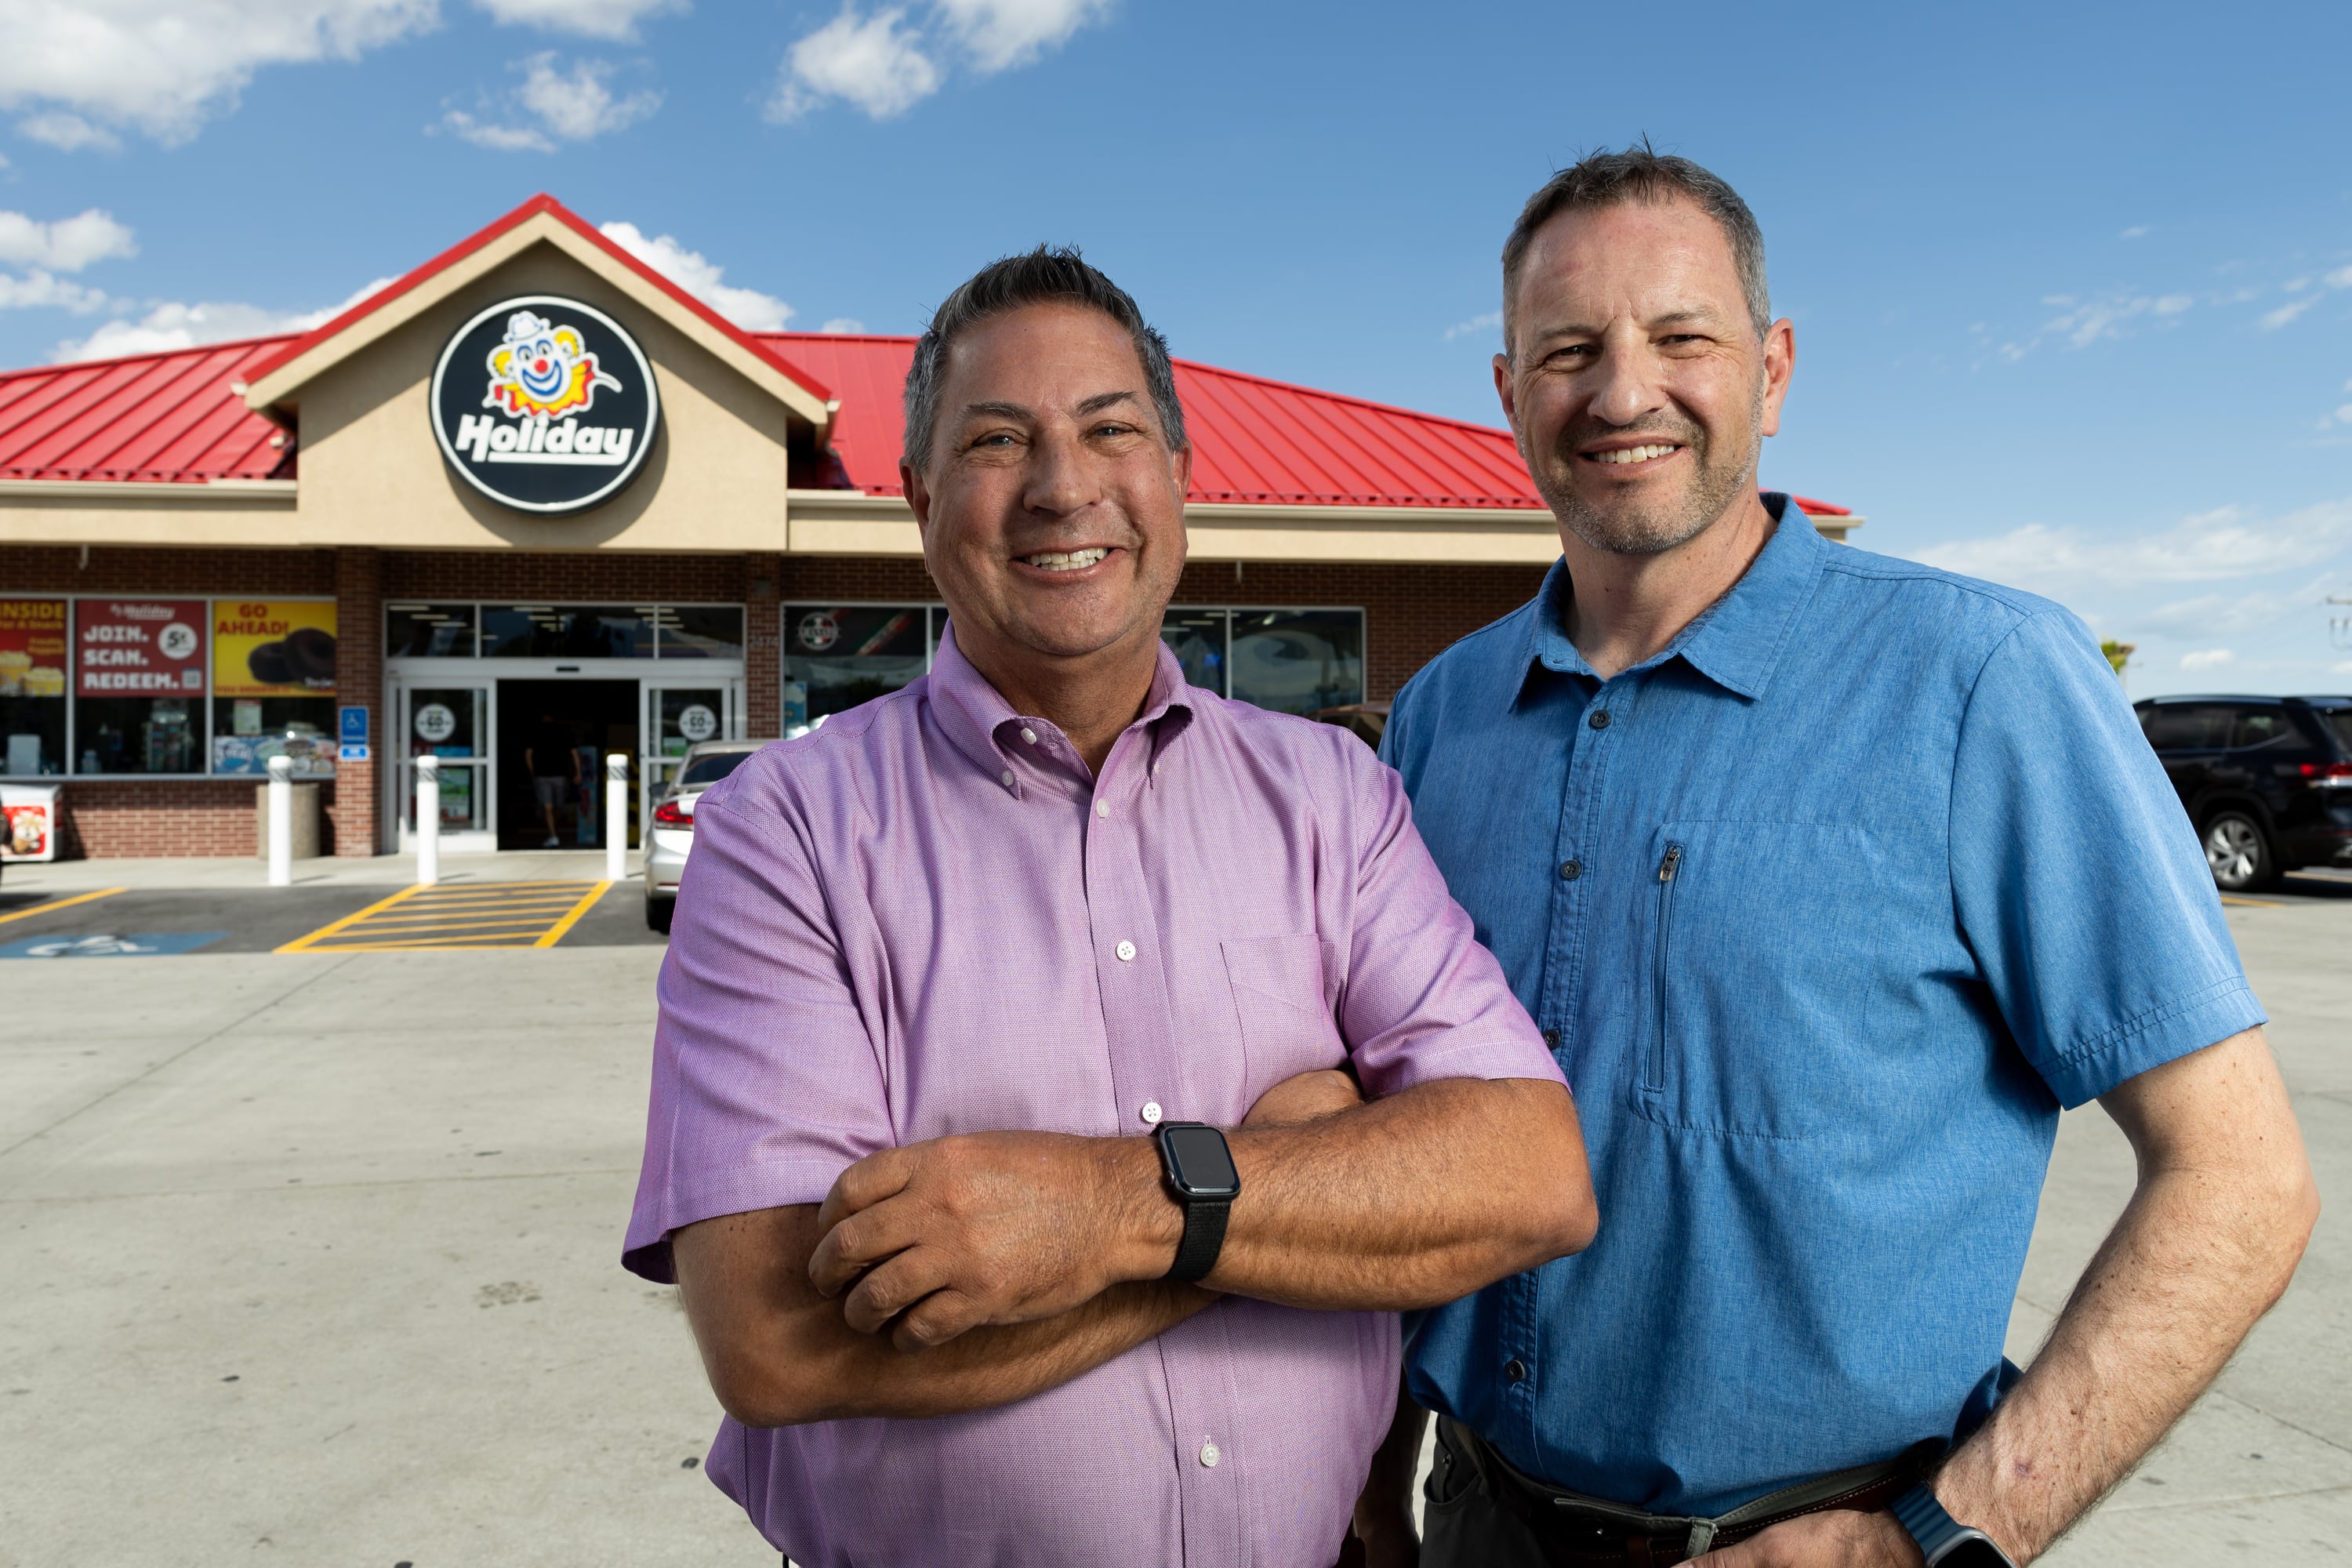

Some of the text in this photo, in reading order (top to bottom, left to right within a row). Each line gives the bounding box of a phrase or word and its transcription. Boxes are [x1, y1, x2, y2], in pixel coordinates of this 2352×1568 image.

[455, 413, 634, 466] Holiday
[238, 603, 268, 619] GO
[83, 625, 150, 643] JOIN.
[83, 648, 149, 666] SCAN.
[83, 672, 180, 690] REDEEM.
